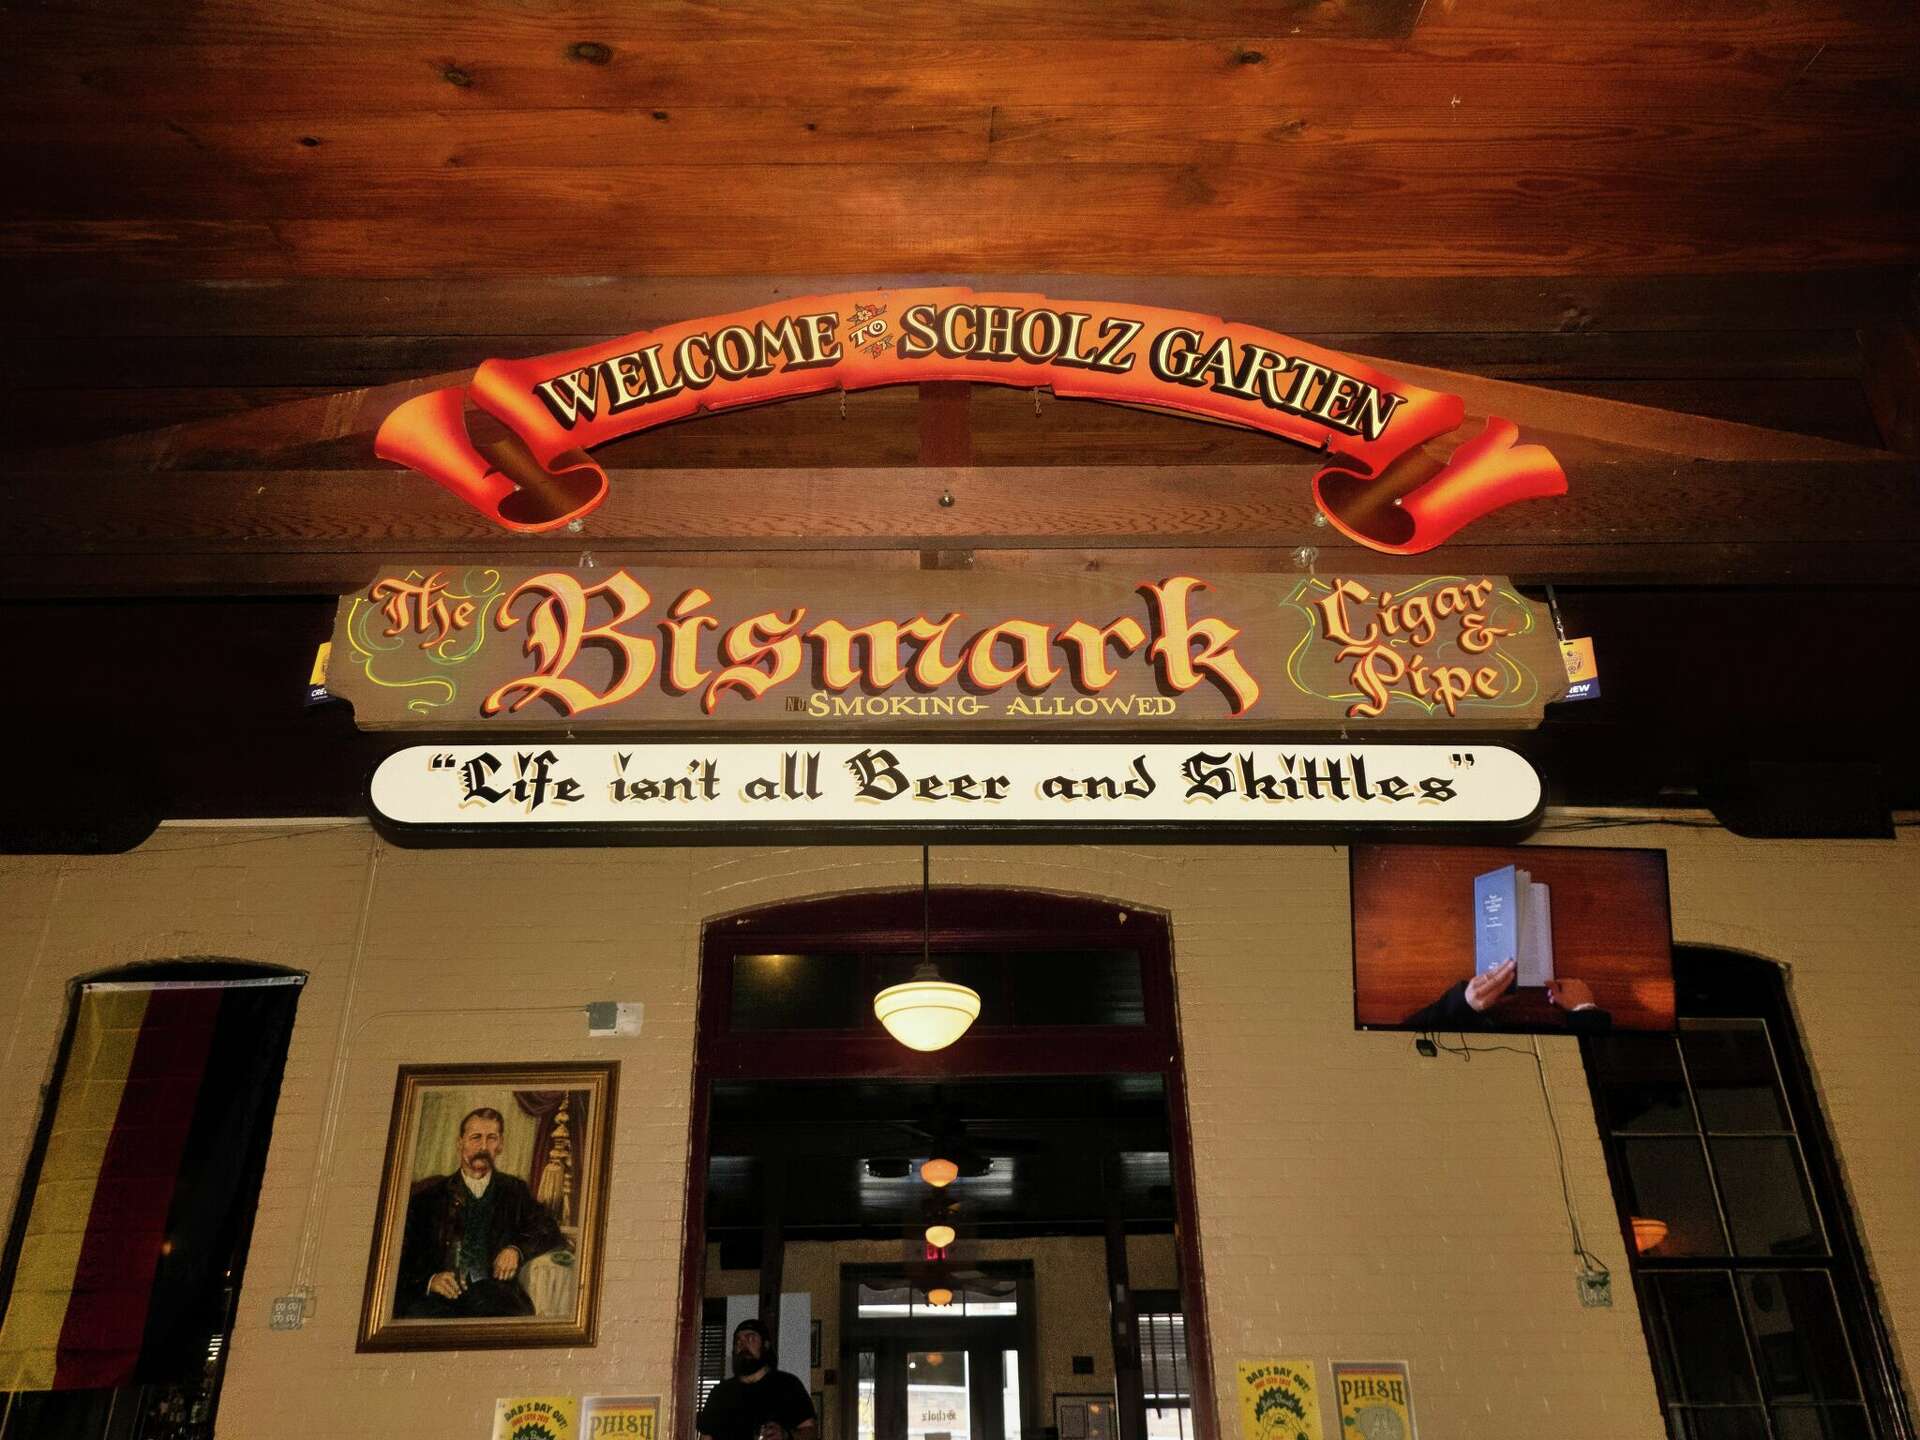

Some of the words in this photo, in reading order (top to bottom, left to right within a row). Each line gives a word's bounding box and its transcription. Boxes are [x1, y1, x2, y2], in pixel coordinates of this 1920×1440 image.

[534, 312, 843, 430] WELCOME
[850, 318, 888, 346] TO
[899, 303, 1144, 373] SCHOLZ
[1150, 326, 1408, 440] GARTEN
[1315, 577, 1493, 648] Cigar
[369, 572, 476, 649] The
[481, 567, 1260, 718] Bismark
[1457, 613, 1512, 654] &
[1334, 644, 1499, 718] Pipe
[785, 696, 806, 711] NO
[807, 691, 990, 717] SMOKING
[1007, 693, 1177, 716] ALLOWED
[430, 749, 586, 812] "Life
[610, 751, 721, 802] isn't
[741, 750, 824, 802] all
[844, 748, 1010, 803] Beer
[1038, 754, 1157, 802] and
[1181, 750, 1475, 804] Skittles"
[1246, 1366, 1271, 1384] DAD'S
[1273, 1366, 1292, 1378] DAY
[1340, 1378, 1404, 1405] PHISH
[503, 1401, 531, 1422] DAD'S
[534, 1401, 553, 1413] DAY
[590, 1413, 653, 1440] PHISH
